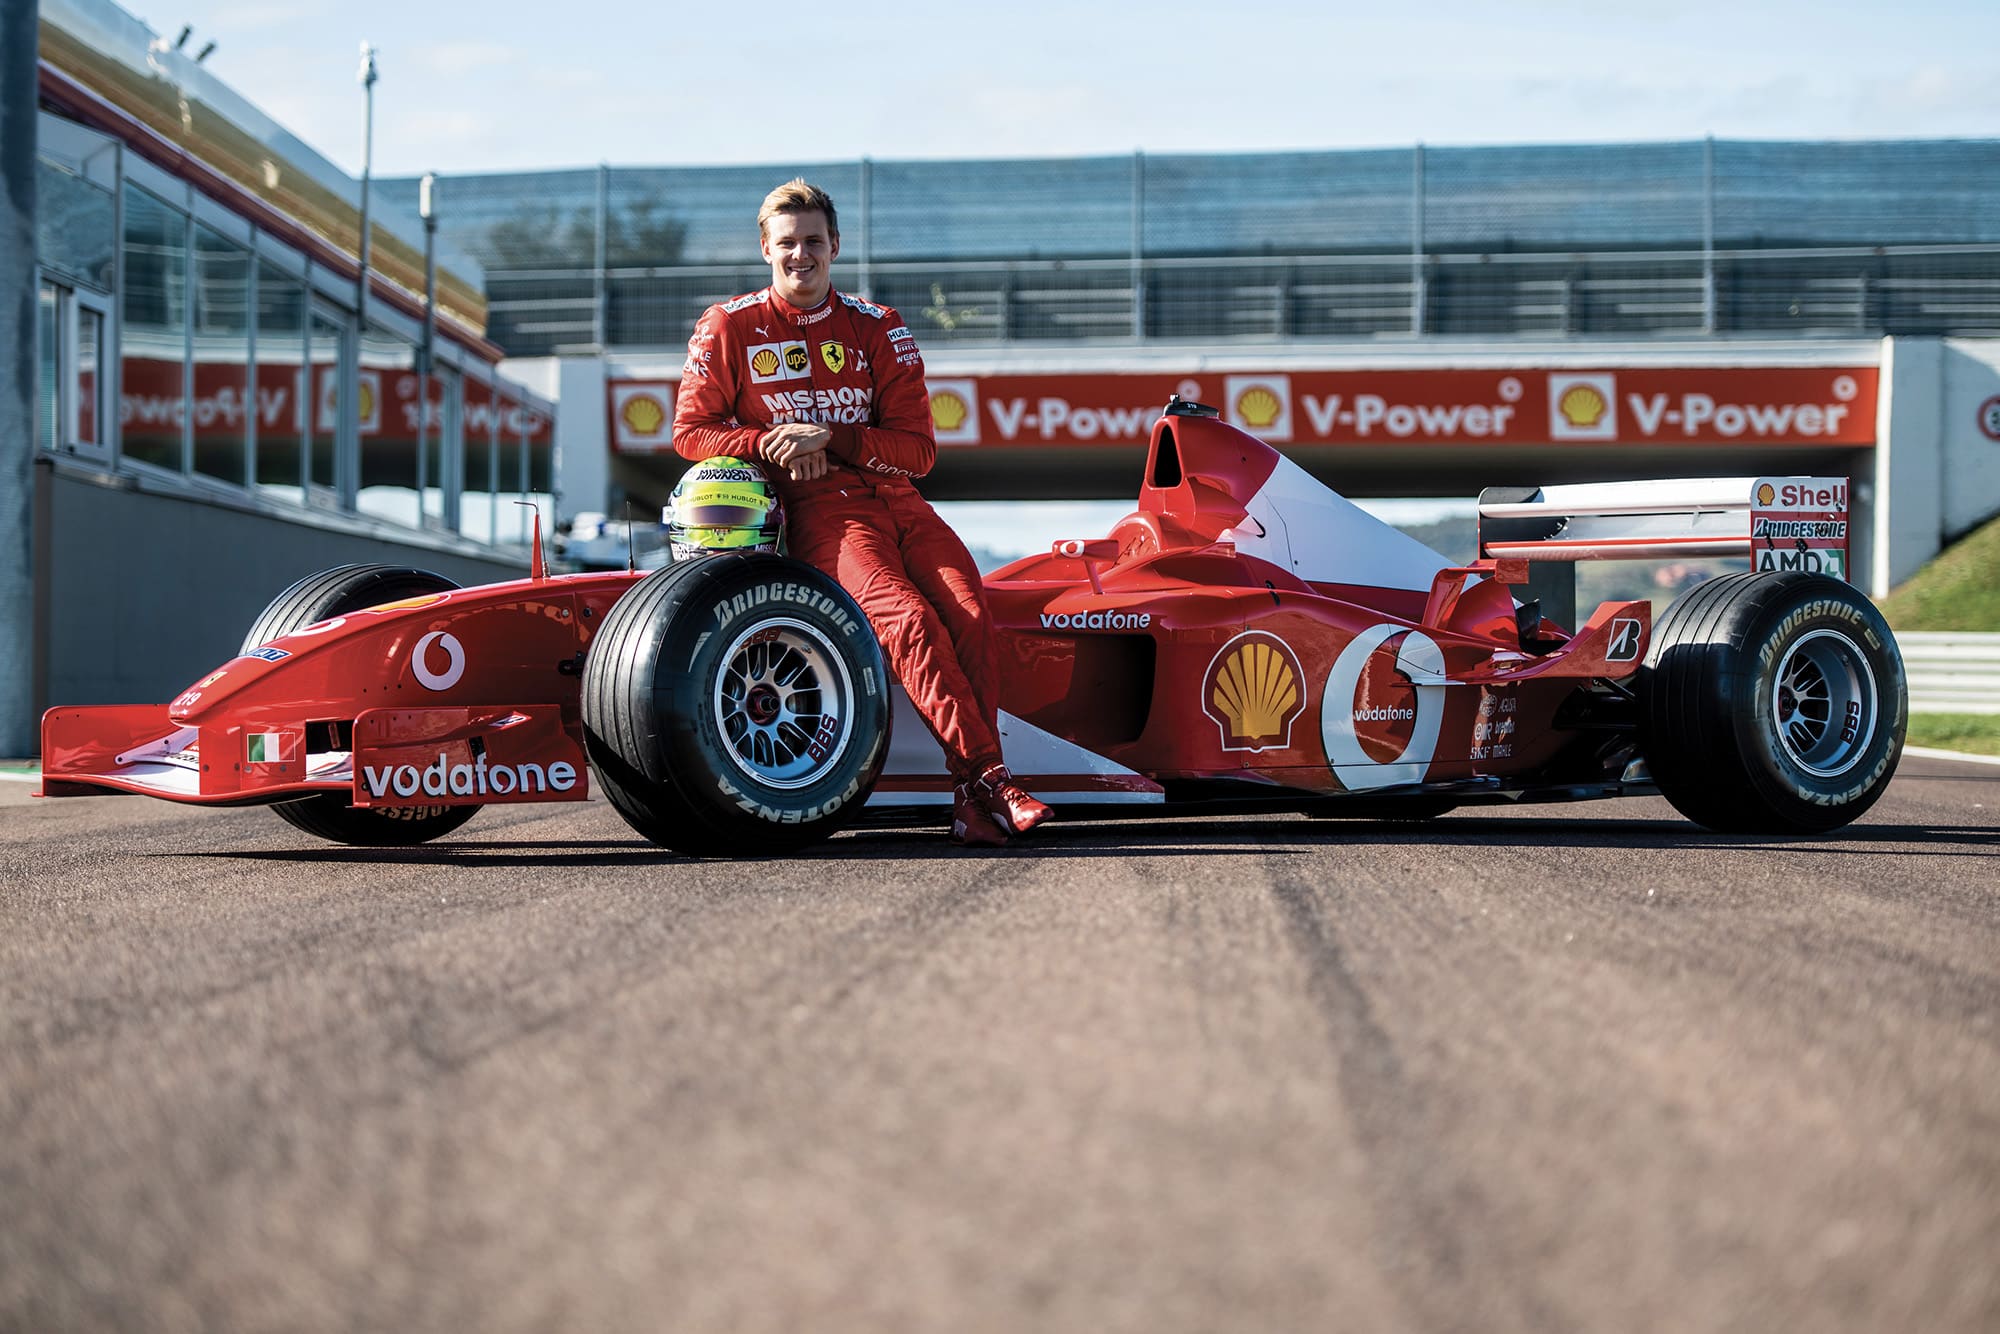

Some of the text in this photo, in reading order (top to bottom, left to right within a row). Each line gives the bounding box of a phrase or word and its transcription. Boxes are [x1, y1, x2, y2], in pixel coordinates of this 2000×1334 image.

[787, 353, 807, 369] ups
[761, 387, 873, 413] MISSION
[988, 397, 1154, 439] V-Pow
[1302, 394, 1514, 438] V-Power
[1628, 393, 1848, 436] V-Power
[731, 494, 757, 504] HUBLOT
[1781, 485, 1846, 506] Shell
[1752, 517, 1847, 539] BRIDGESTONE
[1760, 551, 1822, 572] AMD
[713, 582, 859, 637] BRIDGESTONE
[1040, 609, 1151, 630] vodafone
[1759, 600, 1863, 669] BRIDGESTONE
[1354, 705, 1414, 722] vodafone
[807, 713, 837, 763] BBS
[364, 752, 578, 798] vodafone
[1798, 736, 1895, 806] POTENZA
[717, 773, 859, 824] POTENZA
